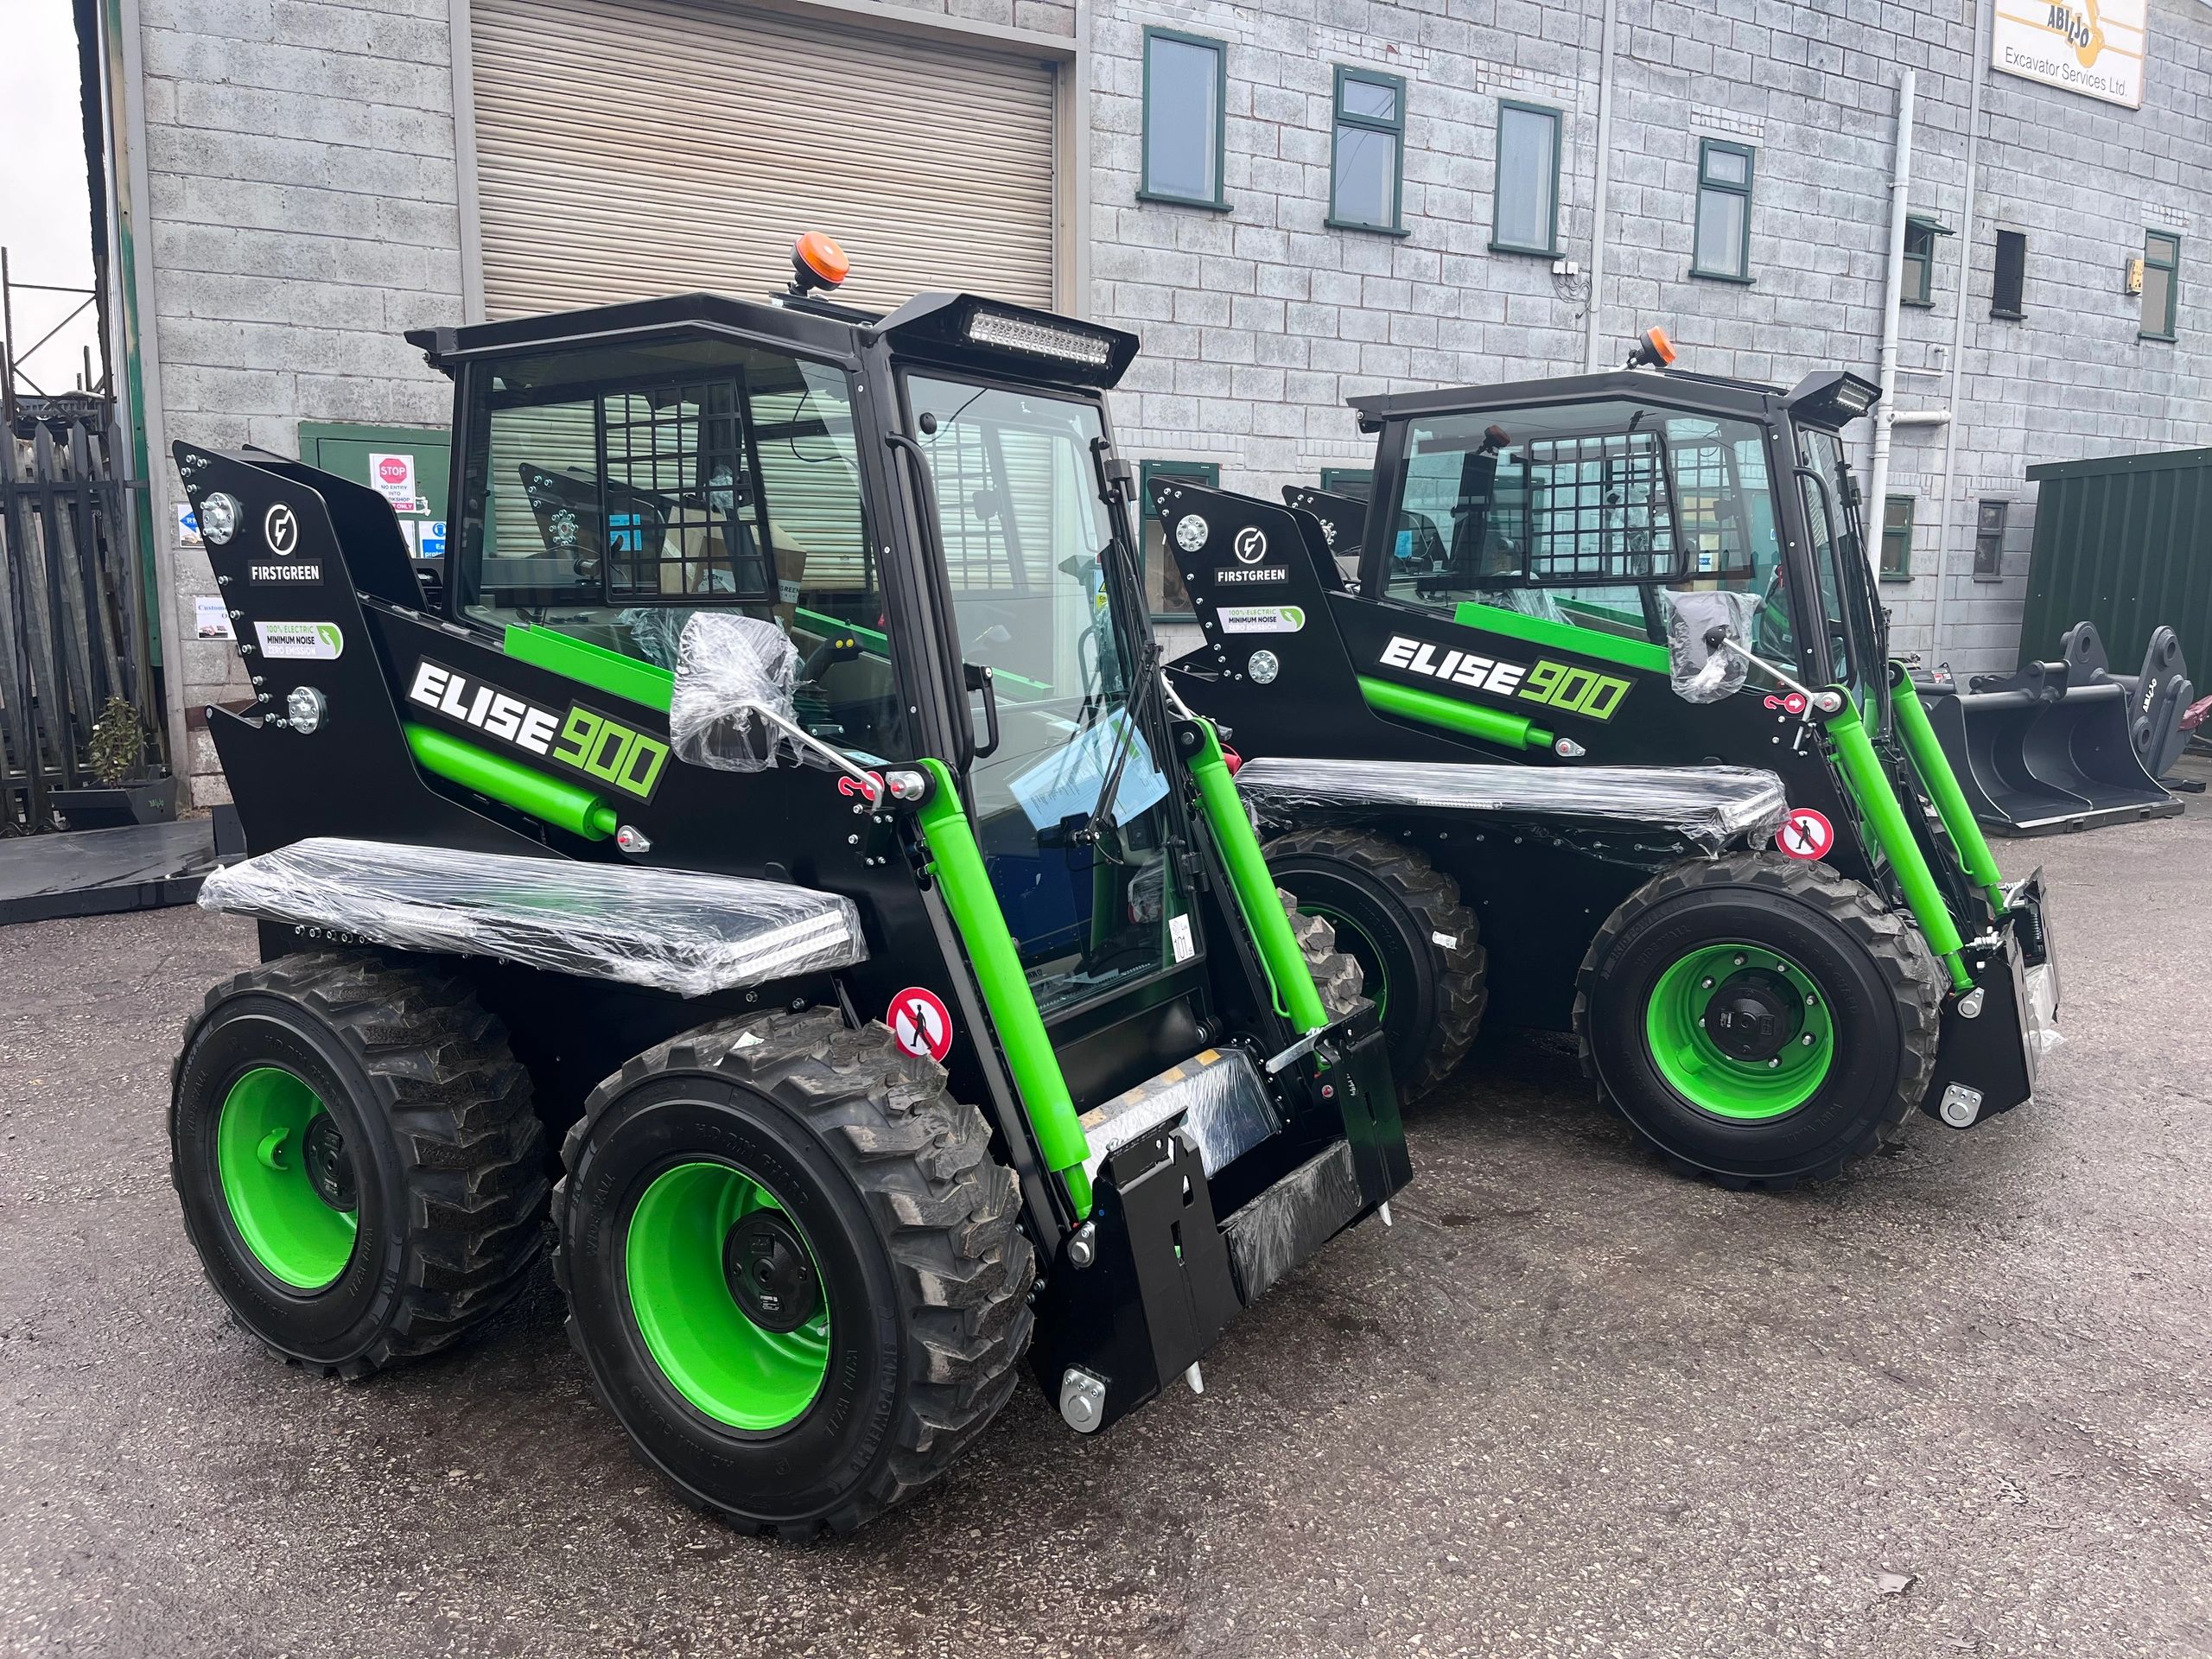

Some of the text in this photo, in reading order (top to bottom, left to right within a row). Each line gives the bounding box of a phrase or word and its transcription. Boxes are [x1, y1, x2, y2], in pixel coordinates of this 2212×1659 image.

[2047, 5, 2089, 48] ABILJO
[2005, 46, 2128, 97] Excavator Services Ltd.
[380, 466, 406, 476] STOP
[251, 565, 320, 580] FIRSTGREEN
[1217, 569, 1286, 582] FIRSTGREEN
[266, 625, 315, 633] 100% ELECTRIC
[267, 636, 315, 645] MINIMUM NOISE
[268, 646, 316, 656] ZERO EMISSION
